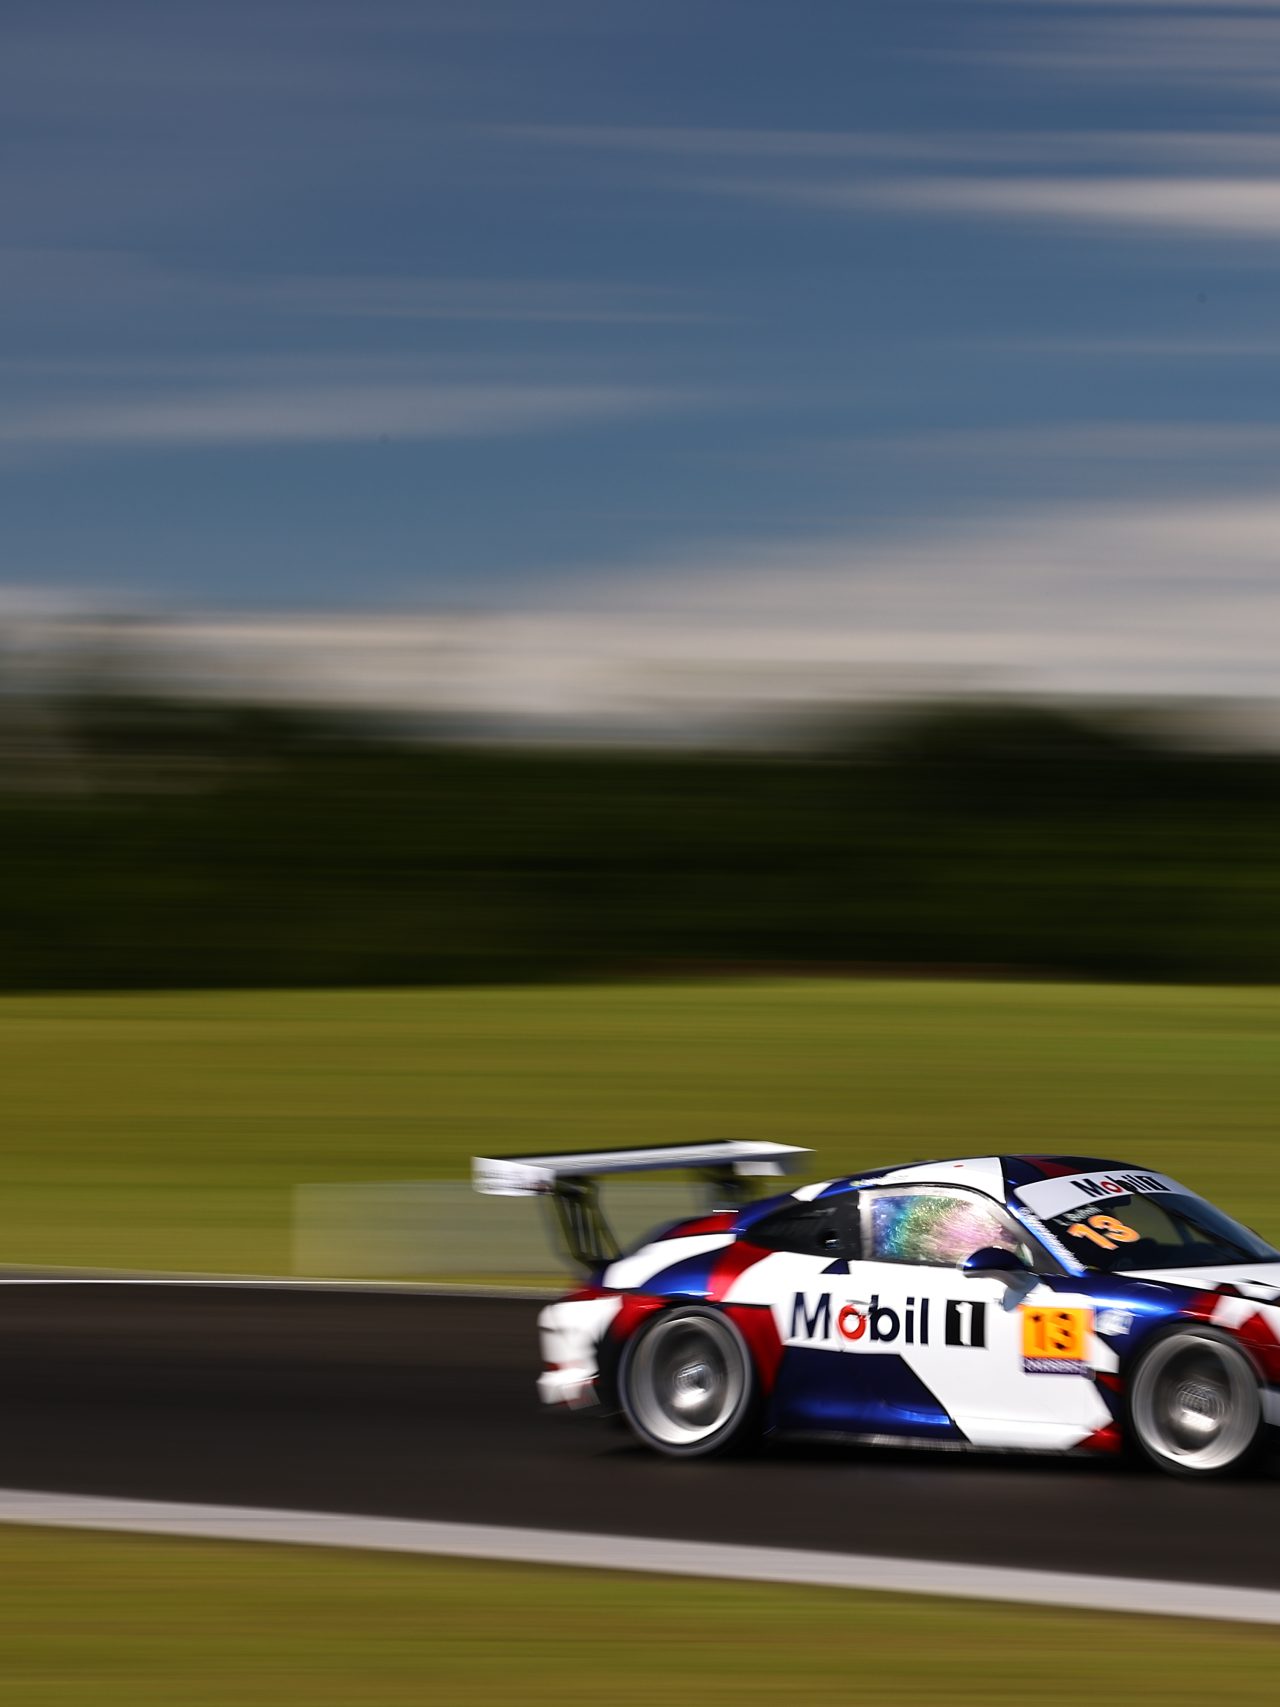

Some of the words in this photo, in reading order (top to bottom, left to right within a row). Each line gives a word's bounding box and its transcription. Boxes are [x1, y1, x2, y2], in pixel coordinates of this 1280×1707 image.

[1066, 1215, 1141, 1251] 13
[790, 1292, 930, 1345] Mobil
[1026, 1310, 1080, 1351] 13
